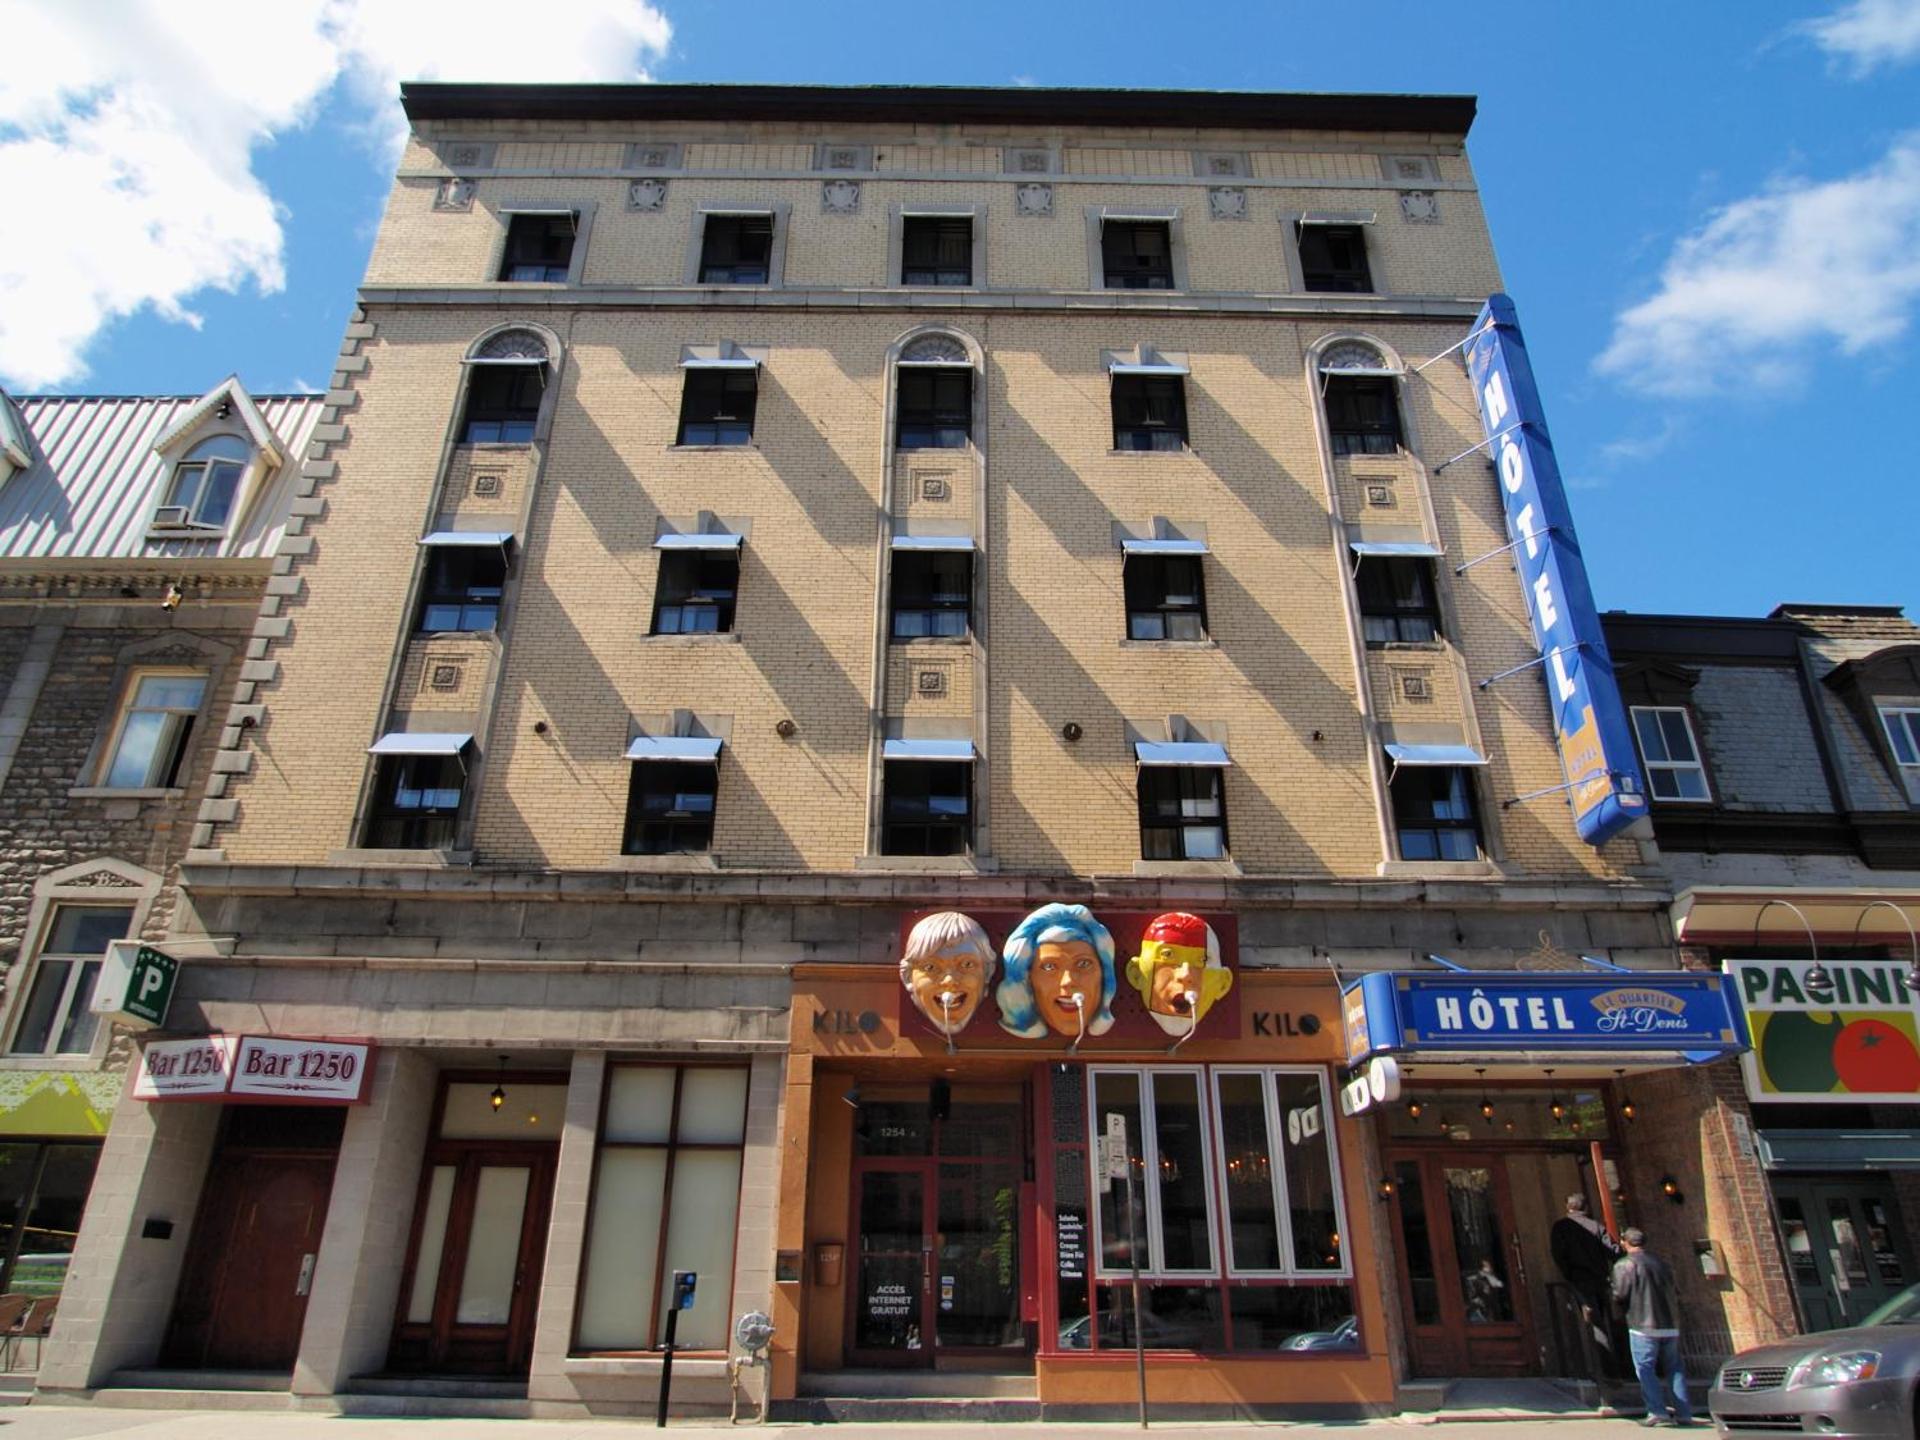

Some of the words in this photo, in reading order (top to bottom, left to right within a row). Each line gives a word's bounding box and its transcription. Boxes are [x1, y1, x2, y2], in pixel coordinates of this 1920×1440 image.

[1484, 370, 1576, 703] HÔTEL
[138, 965, 164, 1001] P
[1436, 988, 1575, 1030] HÔTEL
[1597, 1007, 1689, 1032] St-Denis
[1253, 1012, 1321, 1036] KILO
[146, 1049, 179, 1077] Bar
[180, 1046, 226, 1076] 1250
[244, 1048, 291, 1078] Bar
[295, 1051, 356, 1081] 1250
[881, 1127, 905, 1137] 1254
[869, 1296, 912, 1305] INTERNET
[877, 1283, 905, 1294] ACCÈS
[871, 1306, 910, 1315] GRATUIT
